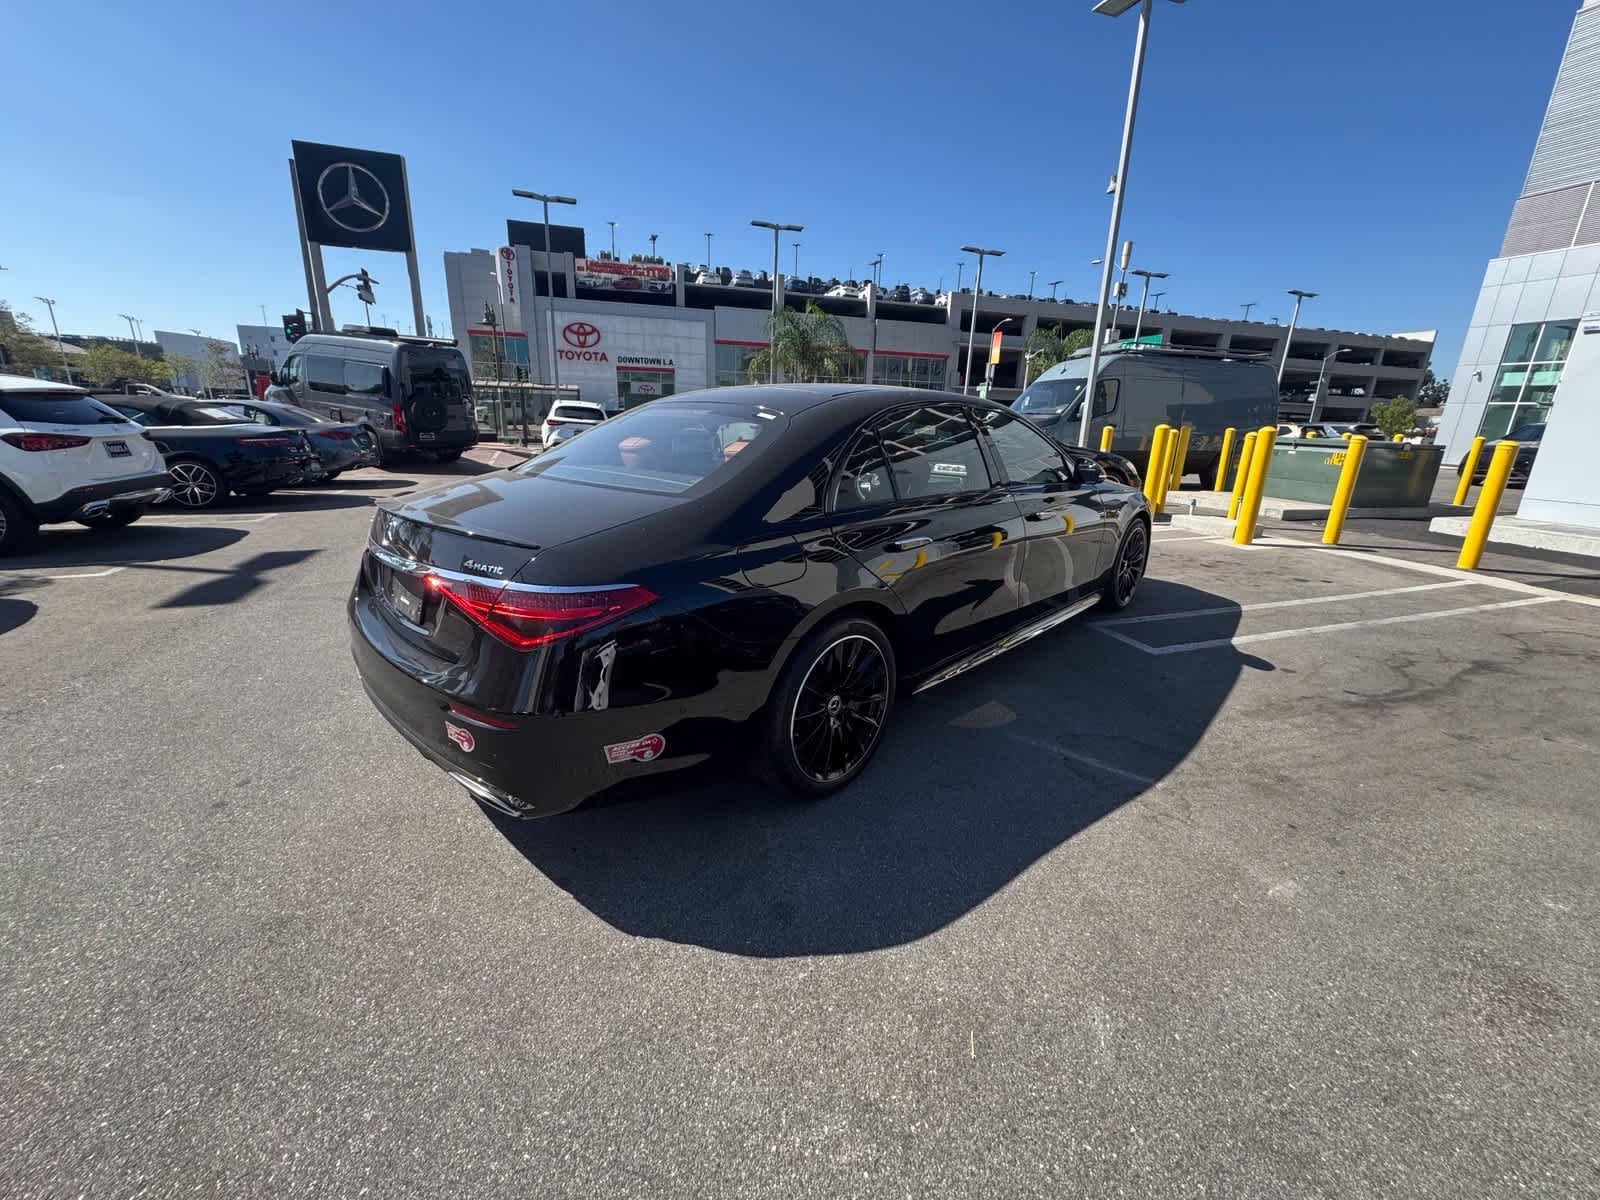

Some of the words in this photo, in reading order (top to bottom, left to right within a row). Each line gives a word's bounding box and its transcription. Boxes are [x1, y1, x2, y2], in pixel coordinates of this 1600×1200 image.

[506, 260, 515, 304] TOYOTA
[558, 350, 608, 362] TOYOTA
[617, 355, 661, 365] DOWNTOWN
[463, 559, 504, 575] 4MATIC
